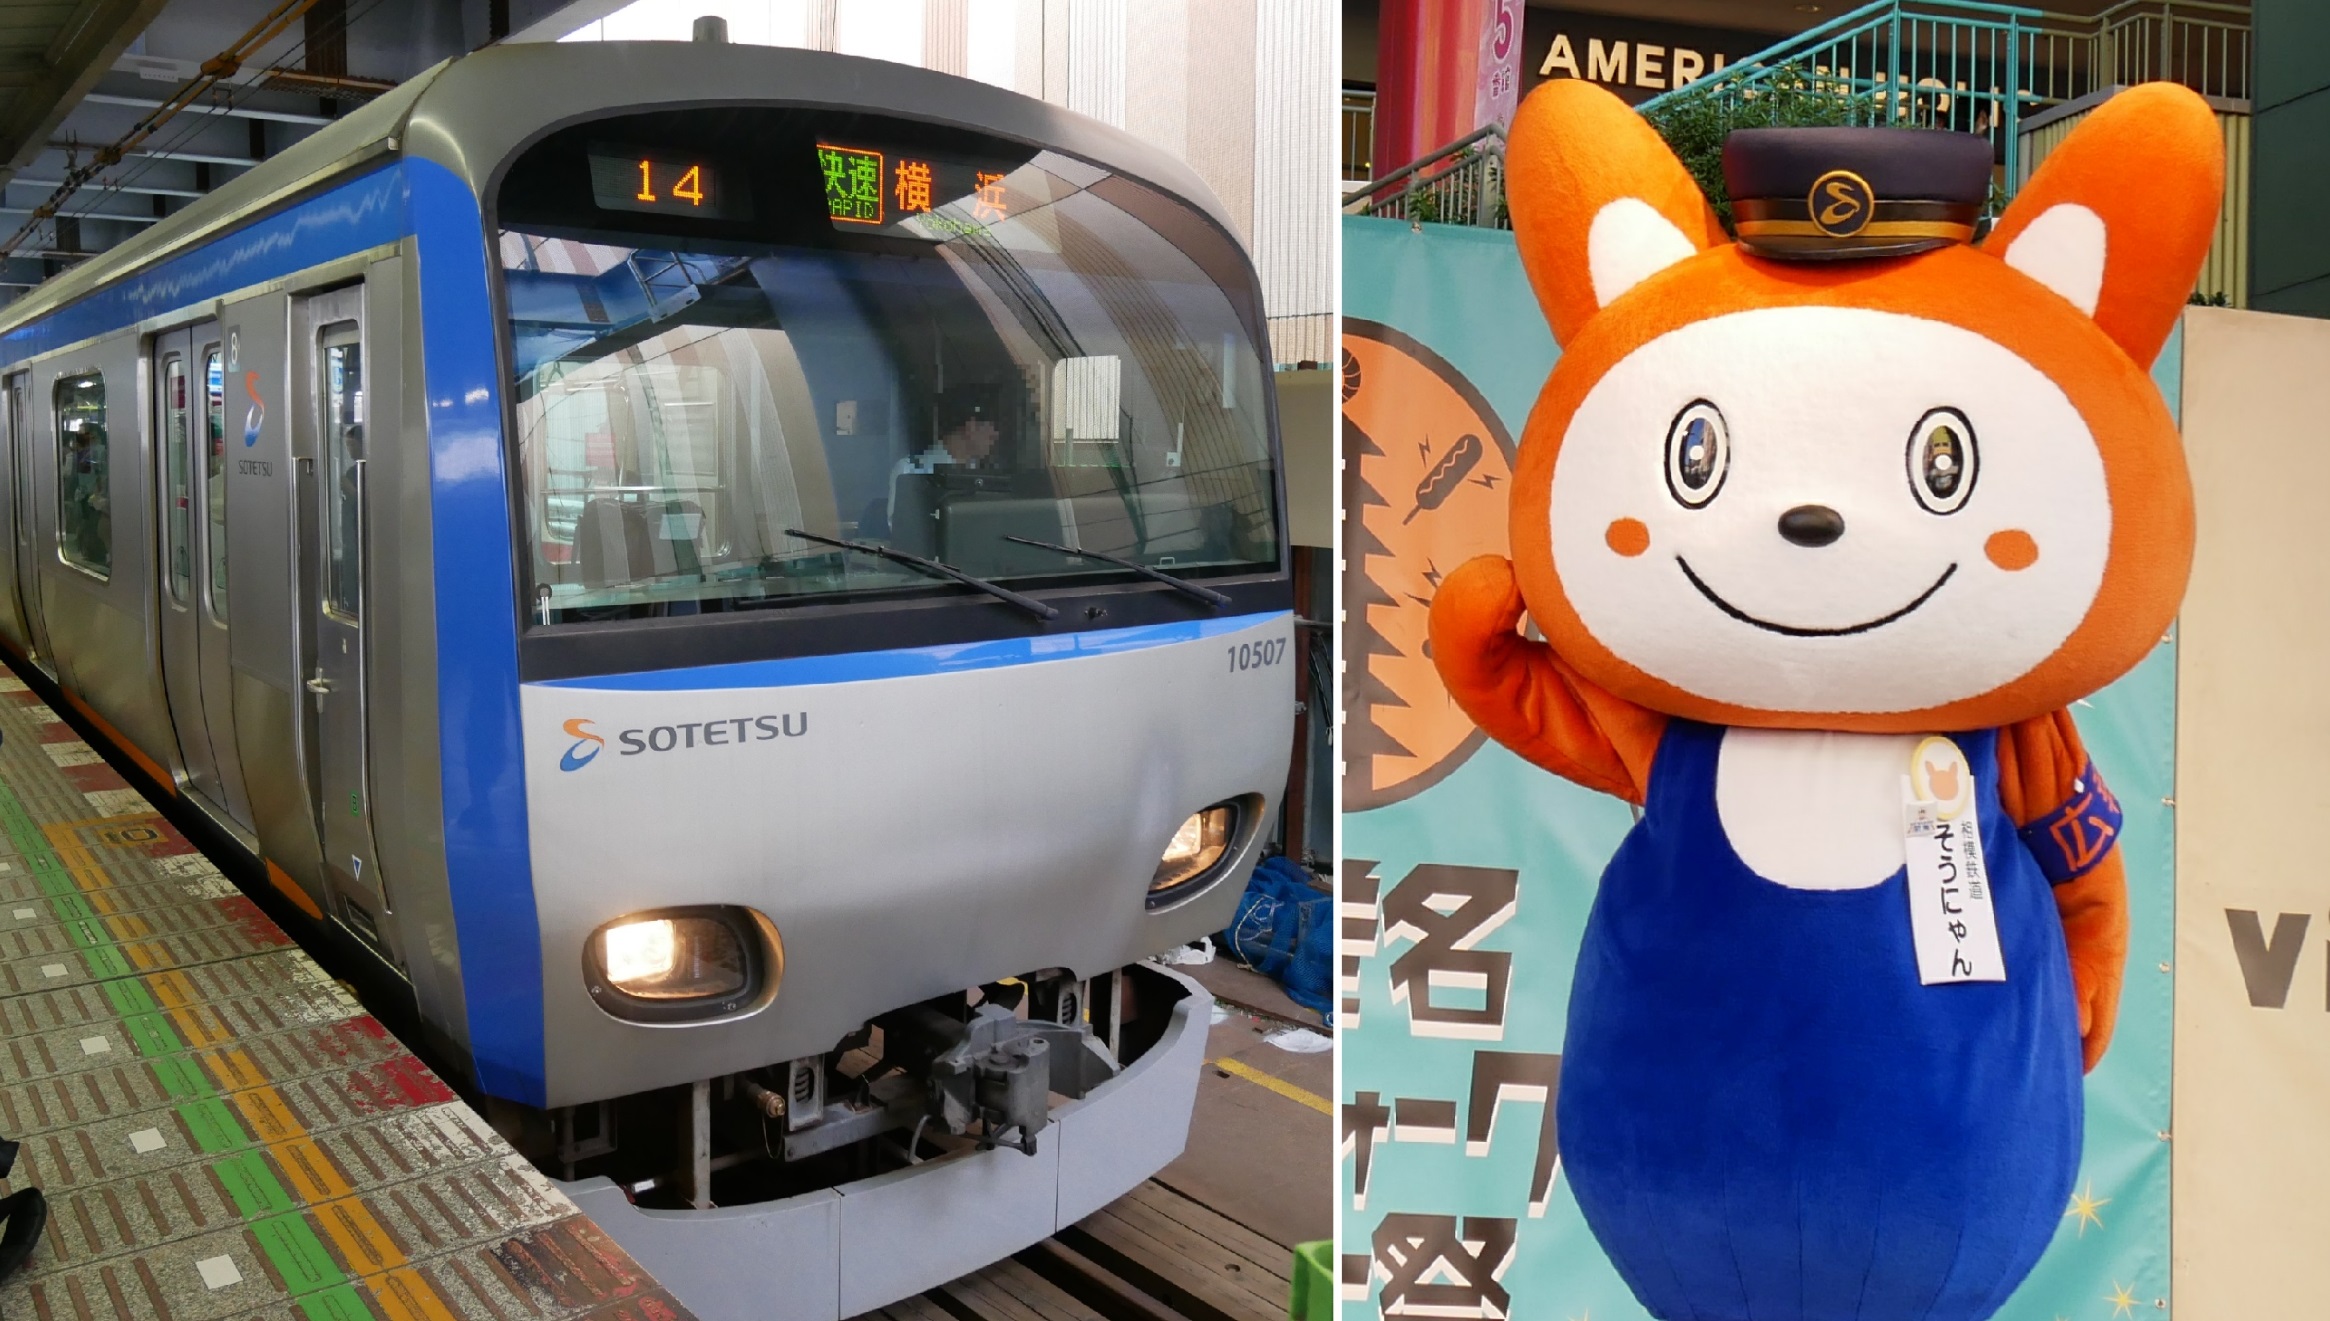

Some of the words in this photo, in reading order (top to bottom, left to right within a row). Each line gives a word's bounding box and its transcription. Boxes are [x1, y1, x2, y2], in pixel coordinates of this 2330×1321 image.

[818, 150, 880, 202] 快速
[828, 198, 875, 218] APID
[238, 460, 273, 477] SOTETSU
[1228, 637, 1287, 672] 10507
[619, 712, 807, 755] SOTETSU
[1934, 824, 1973, 976] そうにゃん
